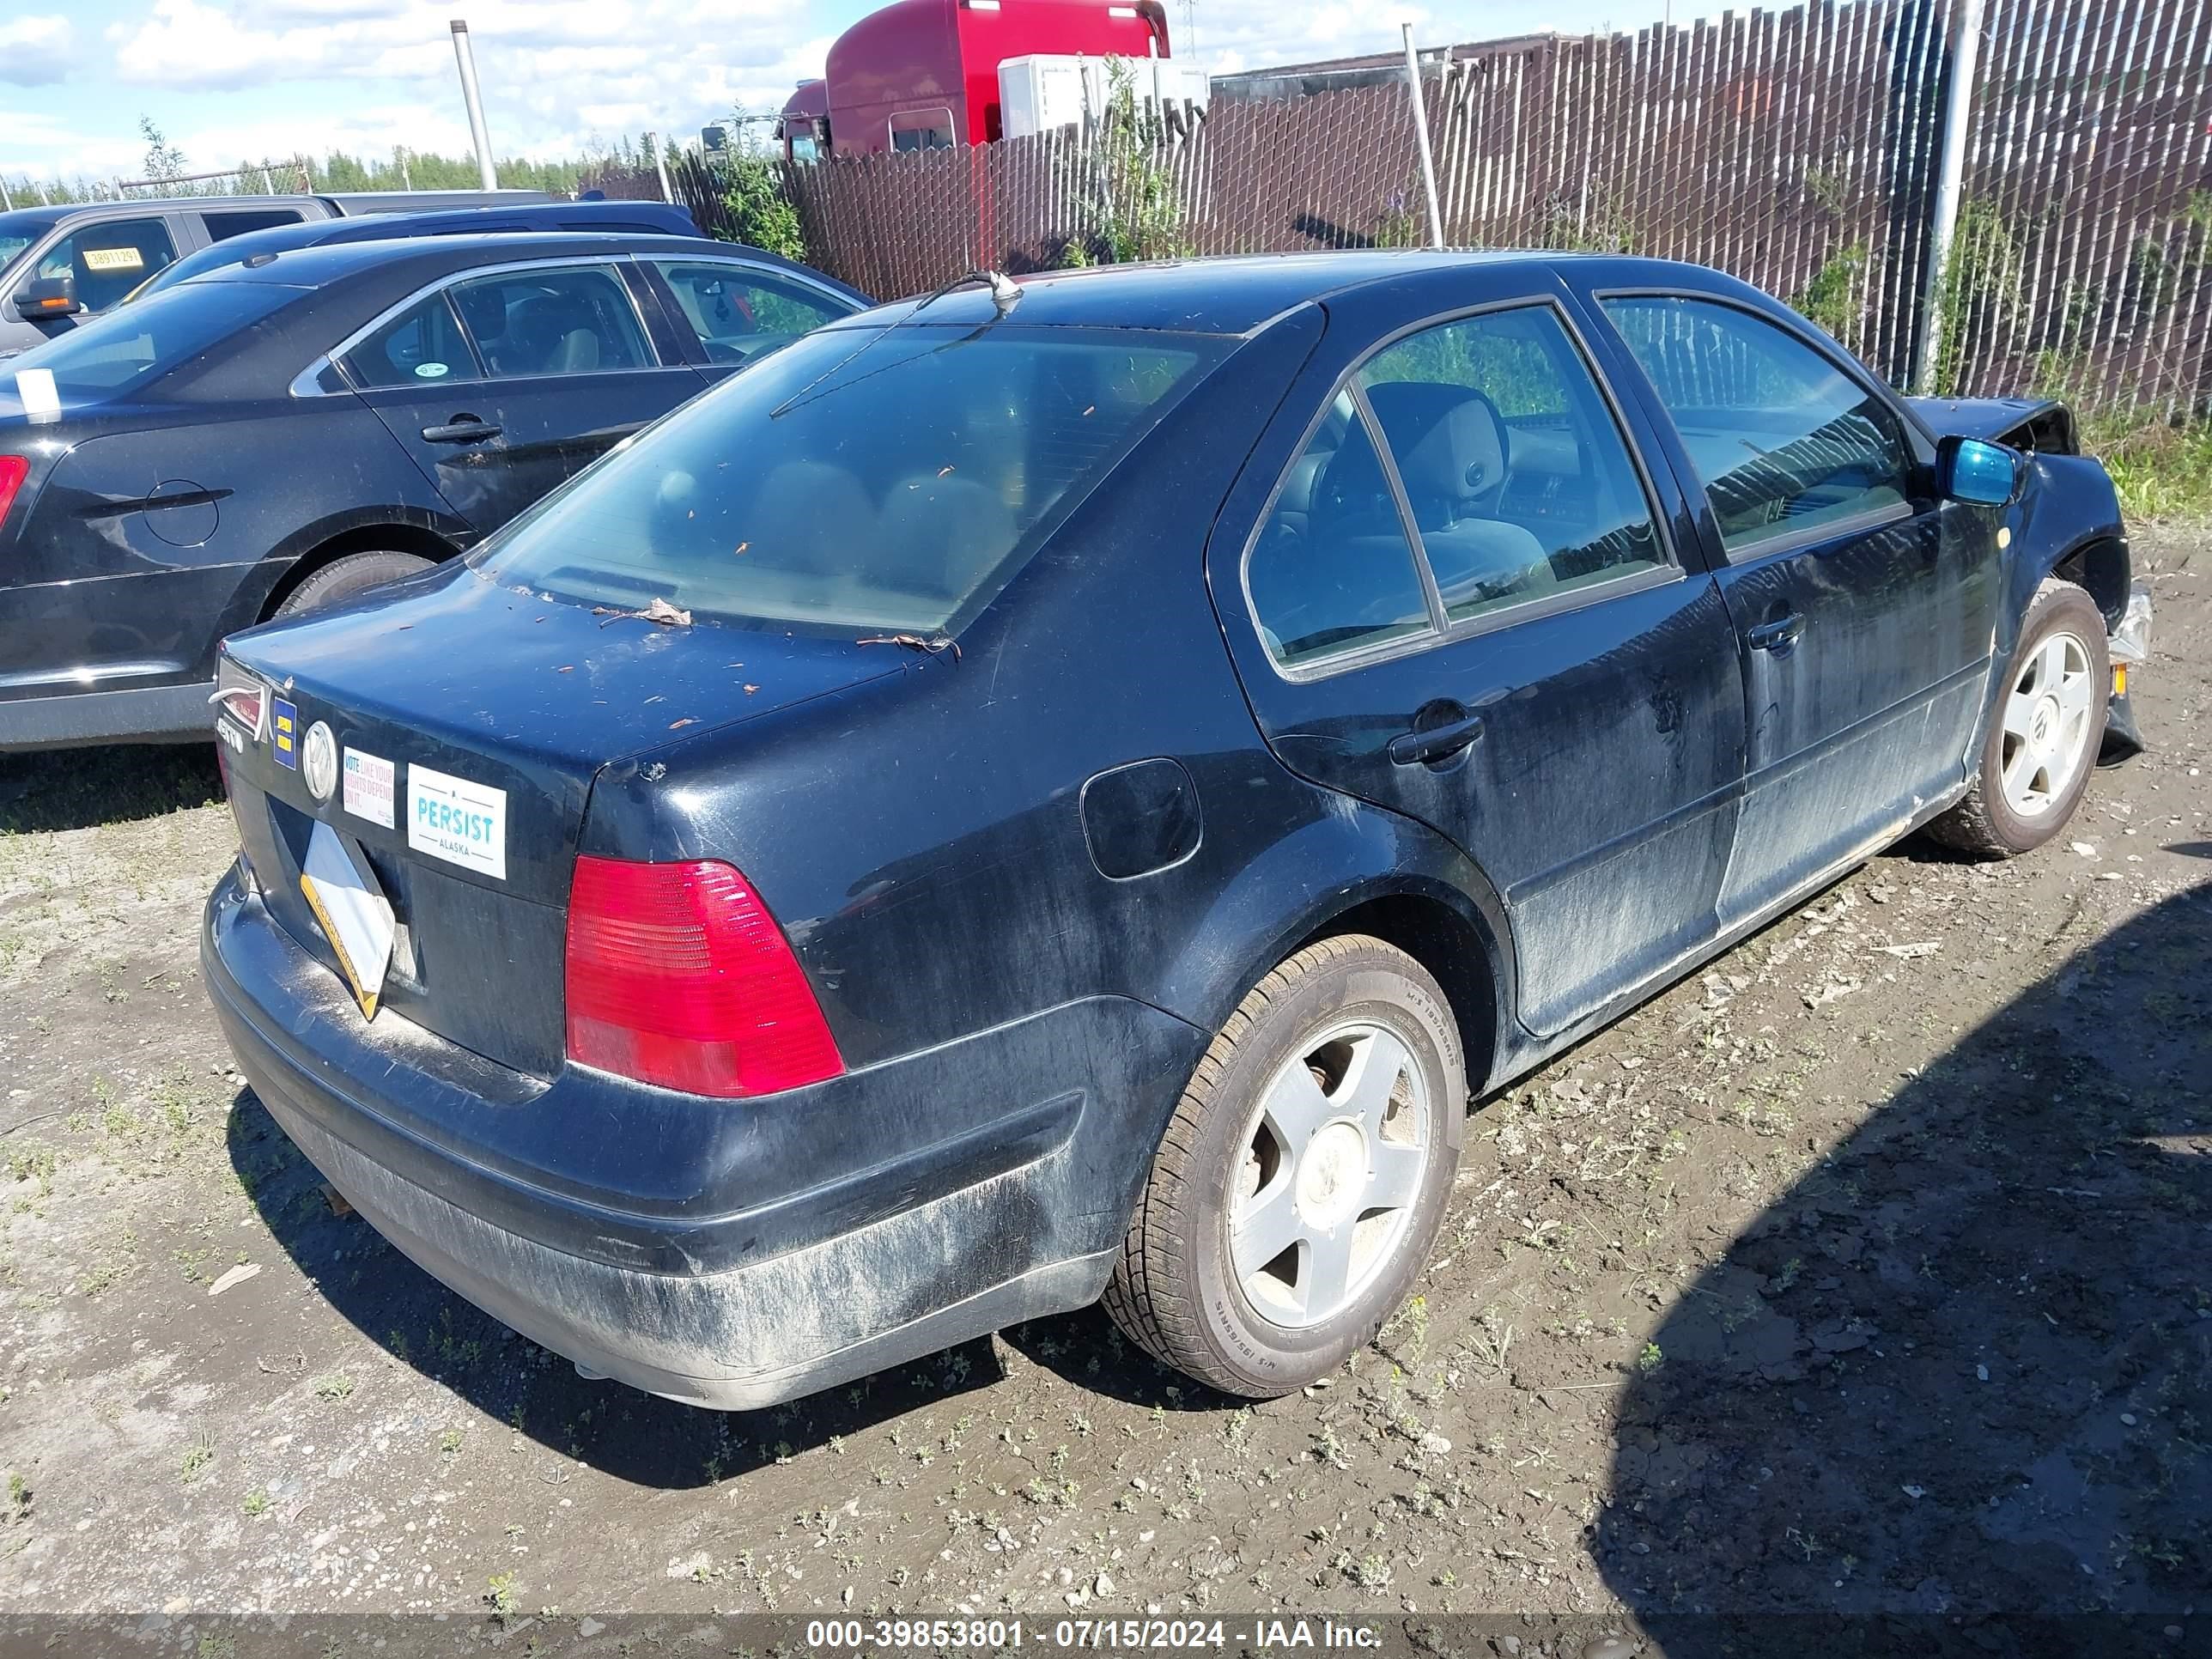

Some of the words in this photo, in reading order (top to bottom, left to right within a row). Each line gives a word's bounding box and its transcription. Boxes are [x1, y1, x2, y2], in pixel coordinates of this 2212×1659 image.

[345, 754, 360, 773] VOTE
[361, 759, 374, 778] LIKE
[374, 764, 392, 784] YOUR
[345, 771, 367, 793] RIGHTS
[368, 779, 392, 802] DEPEND
[345, 788, 354, 805] ON
[418, 797, 493, 844] PERSIST
[440, 838, 469, 856] ALASKA
[1425, 1007, 1455, 1066] 195/65R15
[1215, 1300, 1255, 1359] 195/65R15
